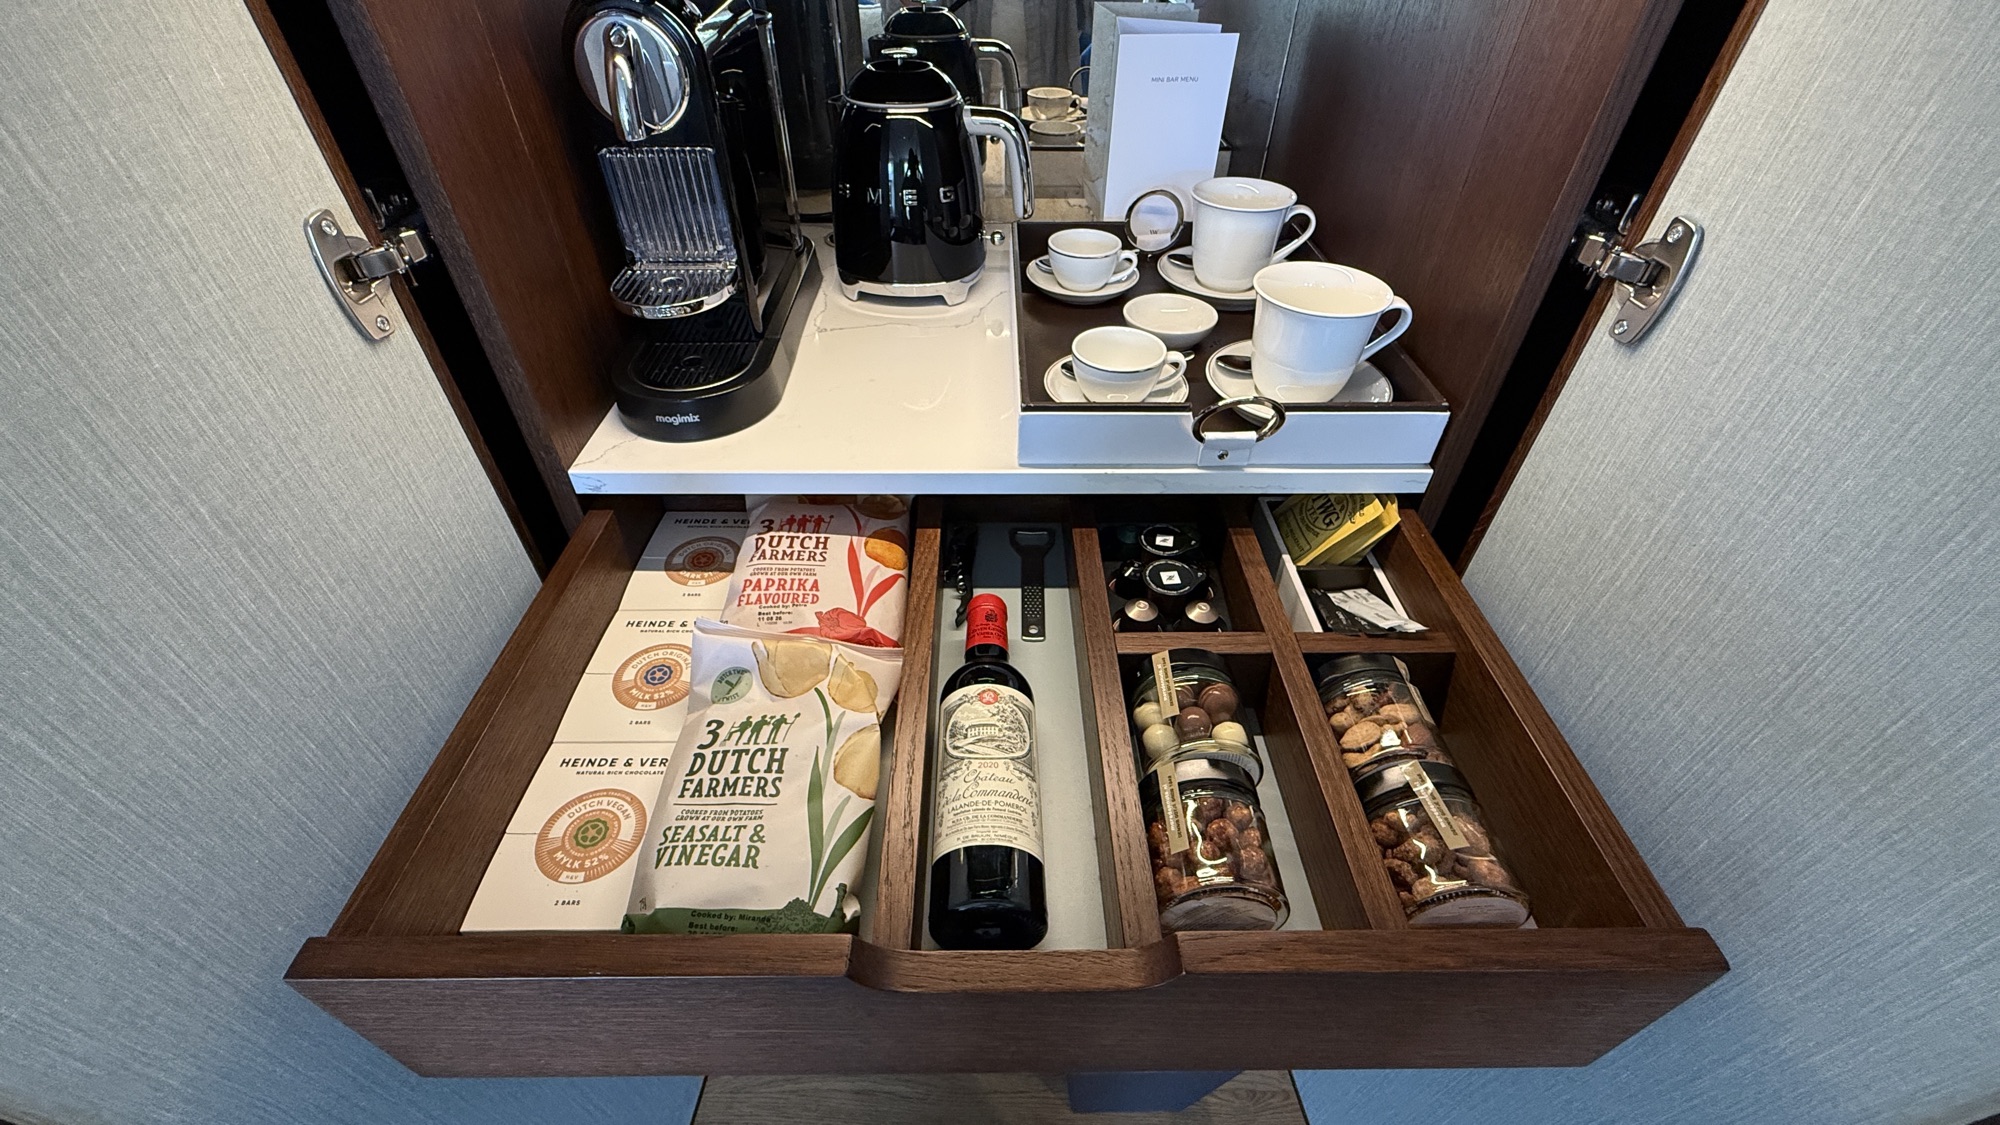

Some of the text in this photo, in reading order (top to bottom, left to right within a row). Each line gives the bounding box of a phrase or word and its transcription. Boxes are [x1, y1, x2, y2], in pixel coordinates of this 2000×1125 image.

[656, 413, 700, 425] magimix
[1307, 505, 1319, 524] TEA
[1312, 494, 1340, 528] TWG
[757, 519, 774, 536] 3
[679, 544, 702, 556] DUTCH
[755, 535, 830, 551] DUTCH
[749, 549, 827, 562] FARMERS
[680, 571, 701, 579] DARK
[742, 578, 819, 593] PAPRIKA
[737, 593, 819, 607] FLAVOURED
[632, 652, 660, 669] DUTCH
[629, 688, 674, 700] MILK 52%
[697, 719, 724, 750] 3
[560, 758, 618, 767] HEINDE
[624, 758, 634, 767] &
[685, 748, 789, 777] DUTCH
[964, 769, 1016, 784] Château
[678, 776, 782, 798] FARMERS
[567, 800, 632, 820] DUTCH VEGAN
[658, 824, 766, 846] SEASALT &
[553, 851, 610, 869] MYLK 52%
[654, 844, 760, 869] VINEGAR
[690, 911, 771, 922] Cooked by: Miranda
[709, 923, 739, 932] before:
